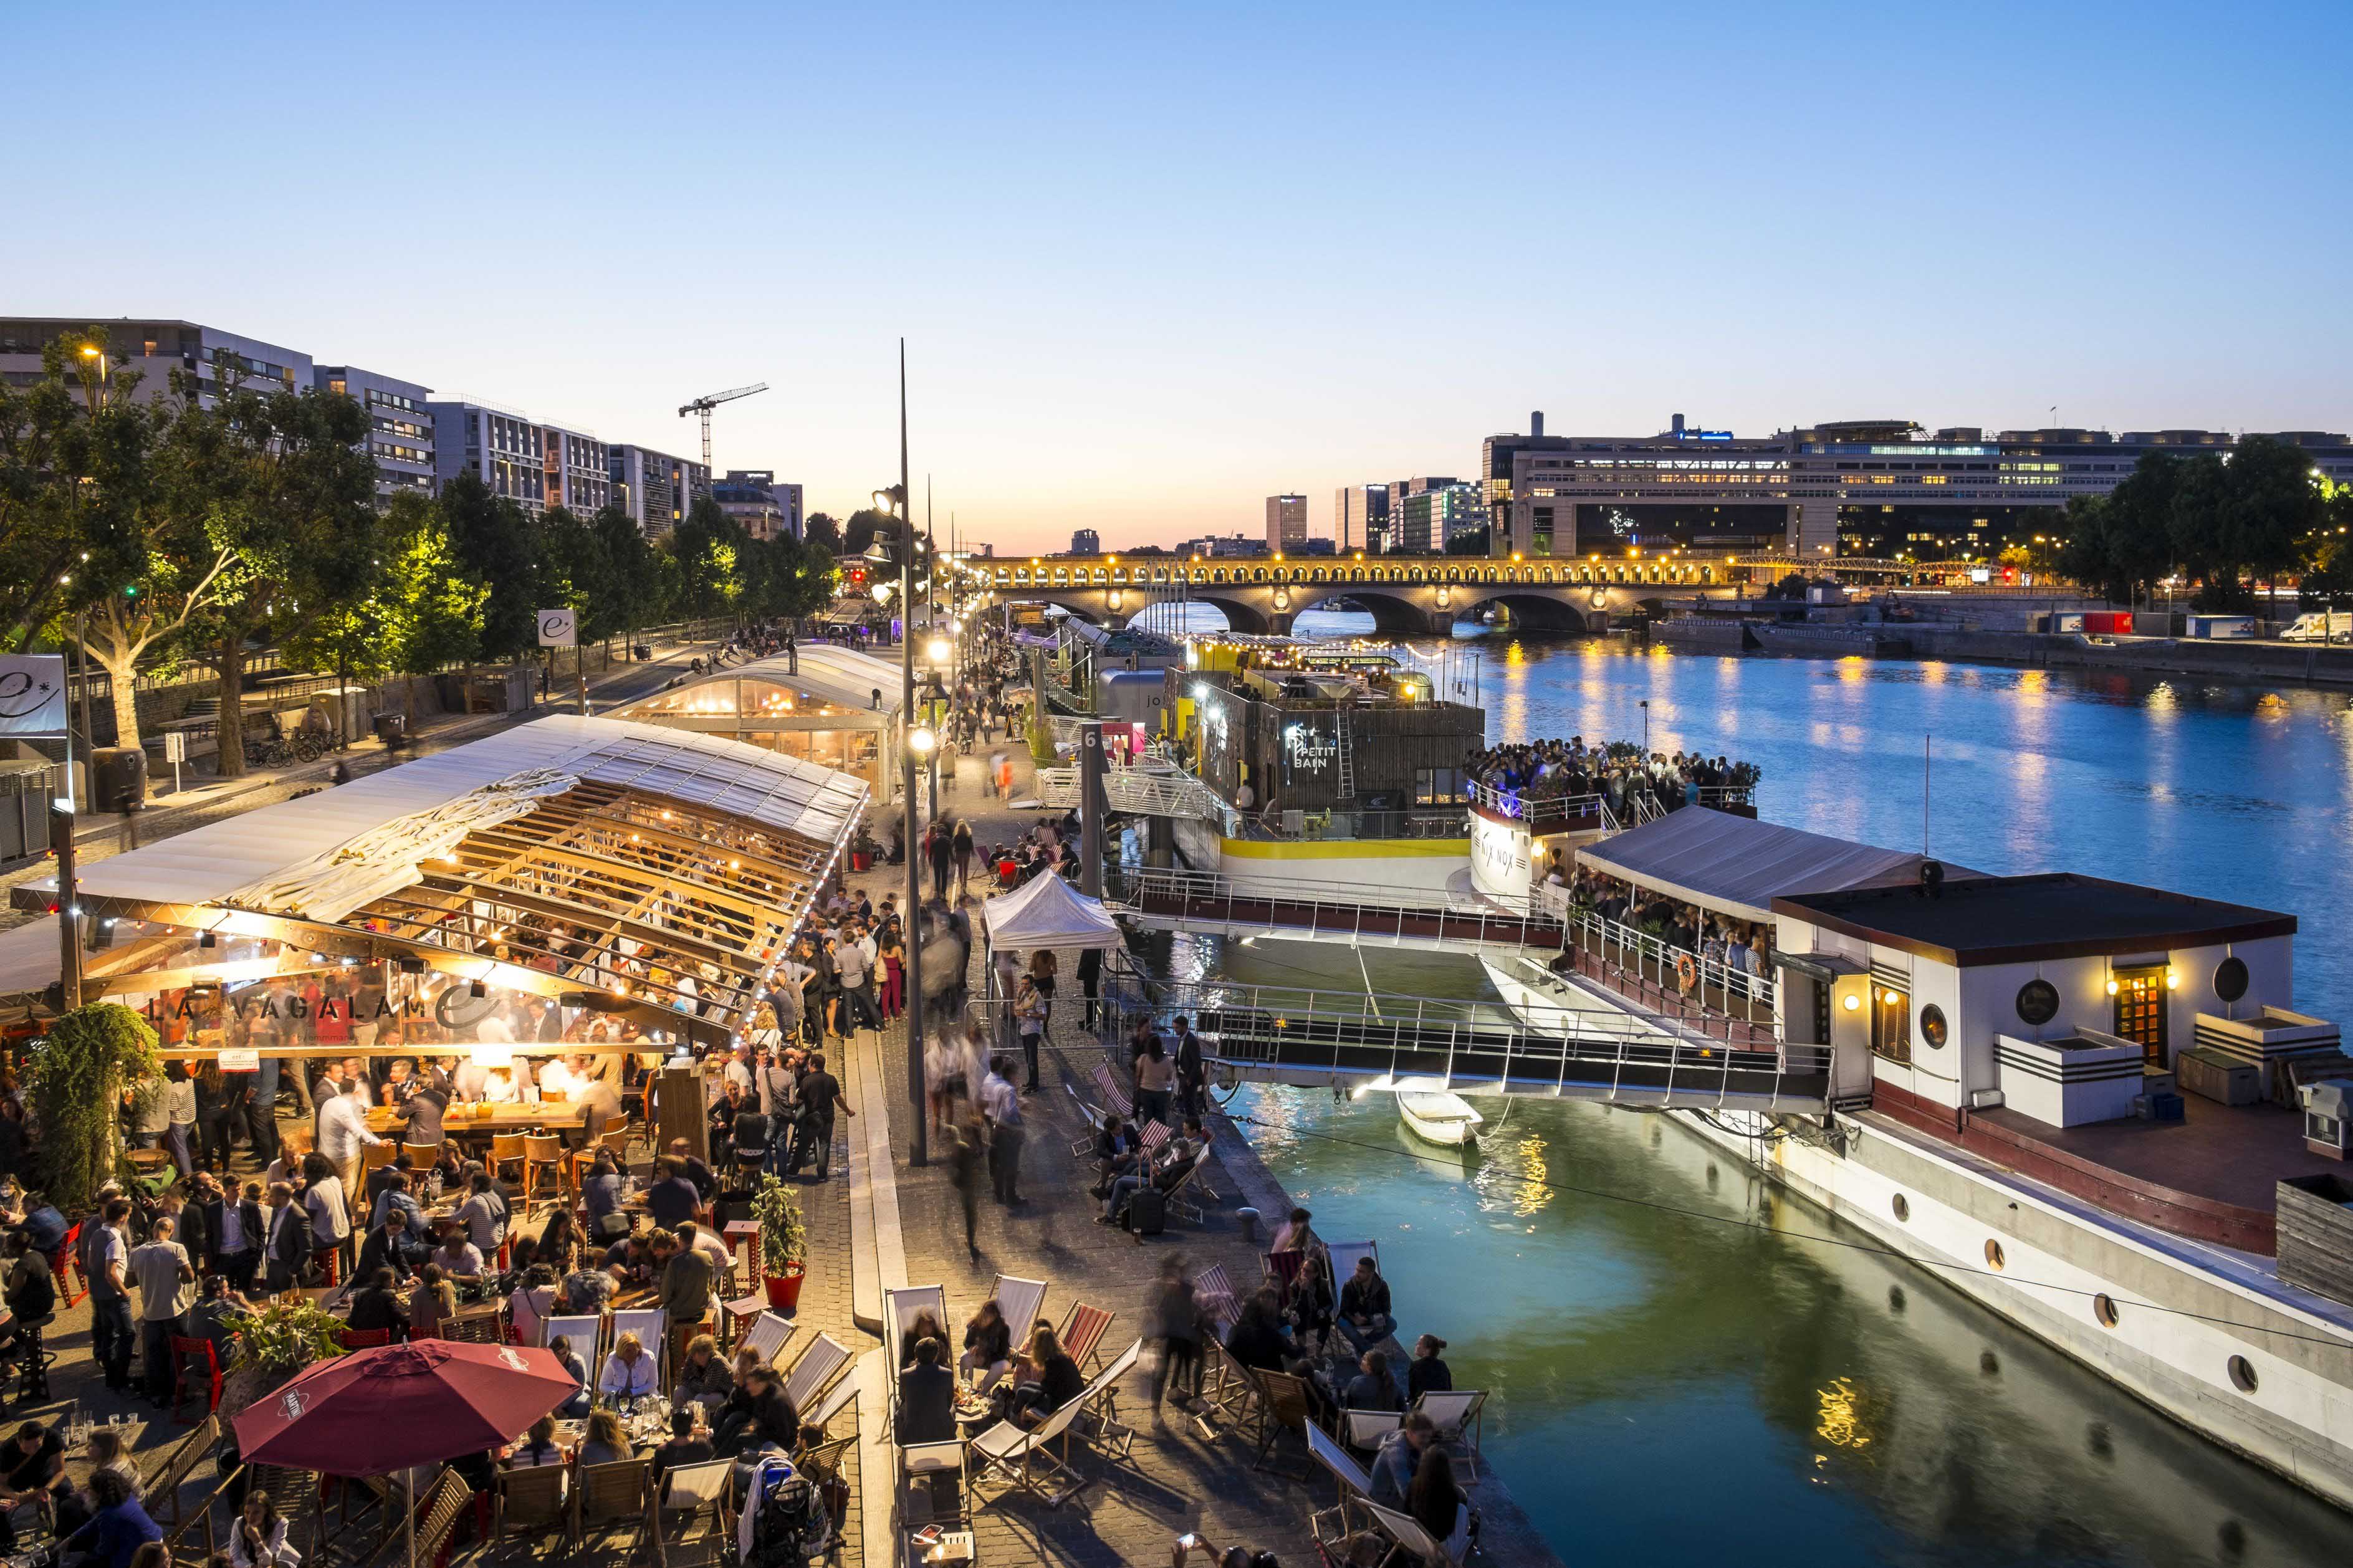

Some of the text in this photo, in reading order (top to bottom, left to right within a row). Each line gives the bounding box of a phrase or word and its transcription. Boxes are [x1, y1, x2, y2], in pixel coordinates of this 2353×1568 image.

[1034, 648, 1040, 656] 7
[1085, 732, 1096, 747] 6
[1301, 747, 1336, 757] PETIT
[1295, 758, 1326, 768] BAIN
[1482, 841, 1513, 877] NIX NOX
[148, 997, 194, 1020] LA
[285, 1392, 302, 1417] MARTINI
